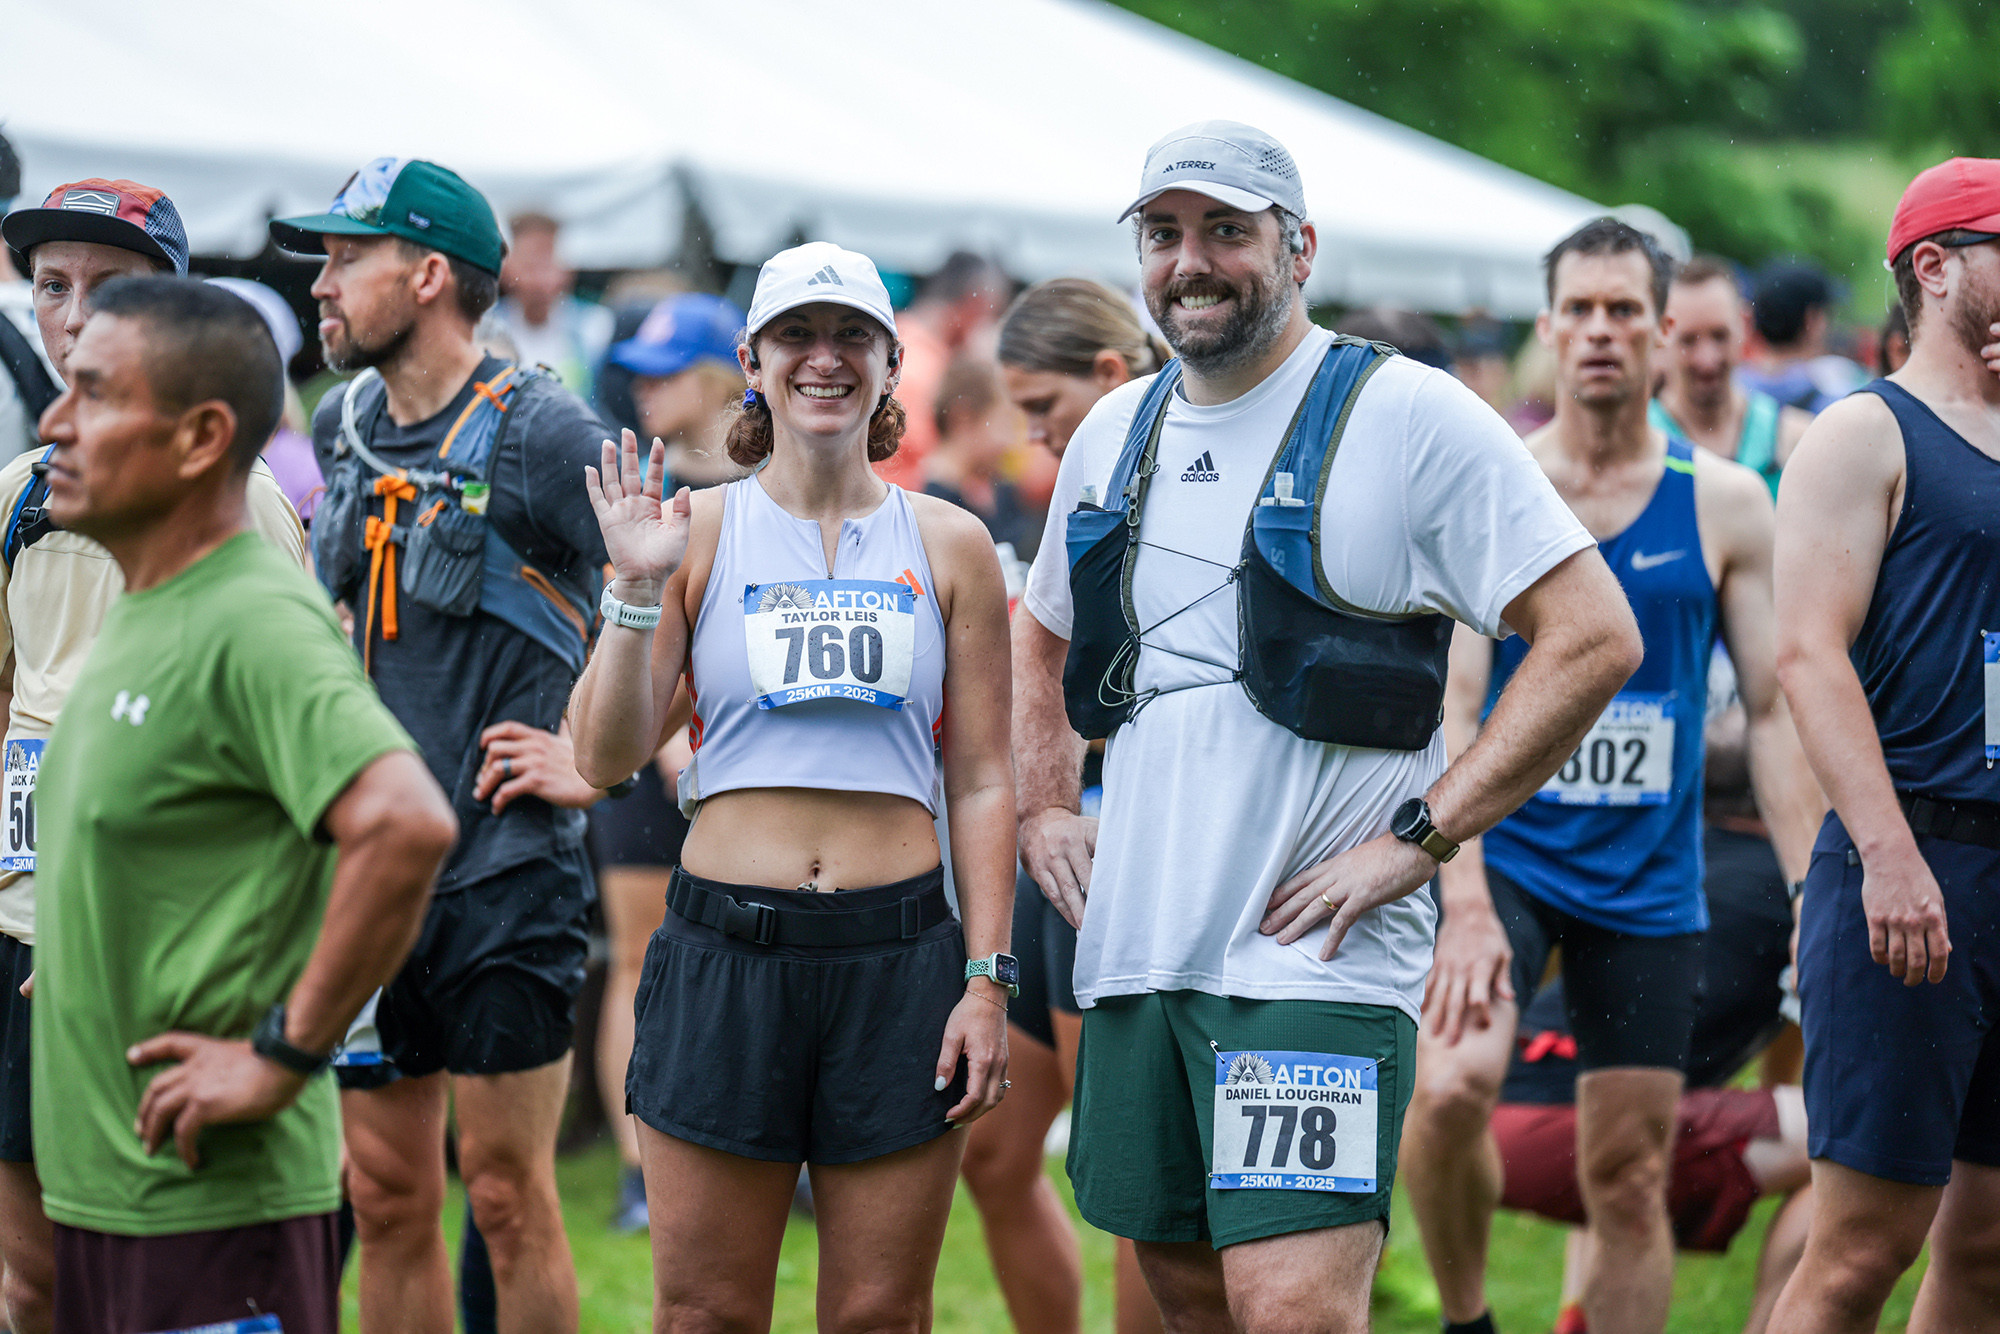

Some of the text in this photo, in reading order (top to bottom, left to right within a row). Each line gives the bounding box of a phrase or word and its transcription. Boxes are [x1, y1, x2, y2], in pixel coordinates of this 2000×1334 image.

[1175, 160, 1216, 171] TERREX
[1180, 470, 1220, 482] adidas
[815, 590, 898, 612] AFTON
[781, 611, 878, 623] TAYLOR LEIS
[775, 624, 883, 685] 760
[786, 685, 831, 703] 25KM
[843, 685, 877, 703] 2025
[11, 775, 28, 786] JACK
[12, 858, 34, 870] 25KM
[1273, 1063, 1361, 1089] AFTON
[1225, 1088, 1362, 1105] DANIEL LOUGHRAN
[1241, 1105, 1337, 1171] 778
[1239, 1175, 1282, 1188] 25KM
[1295, 1175, 1336, 1190] 2025
